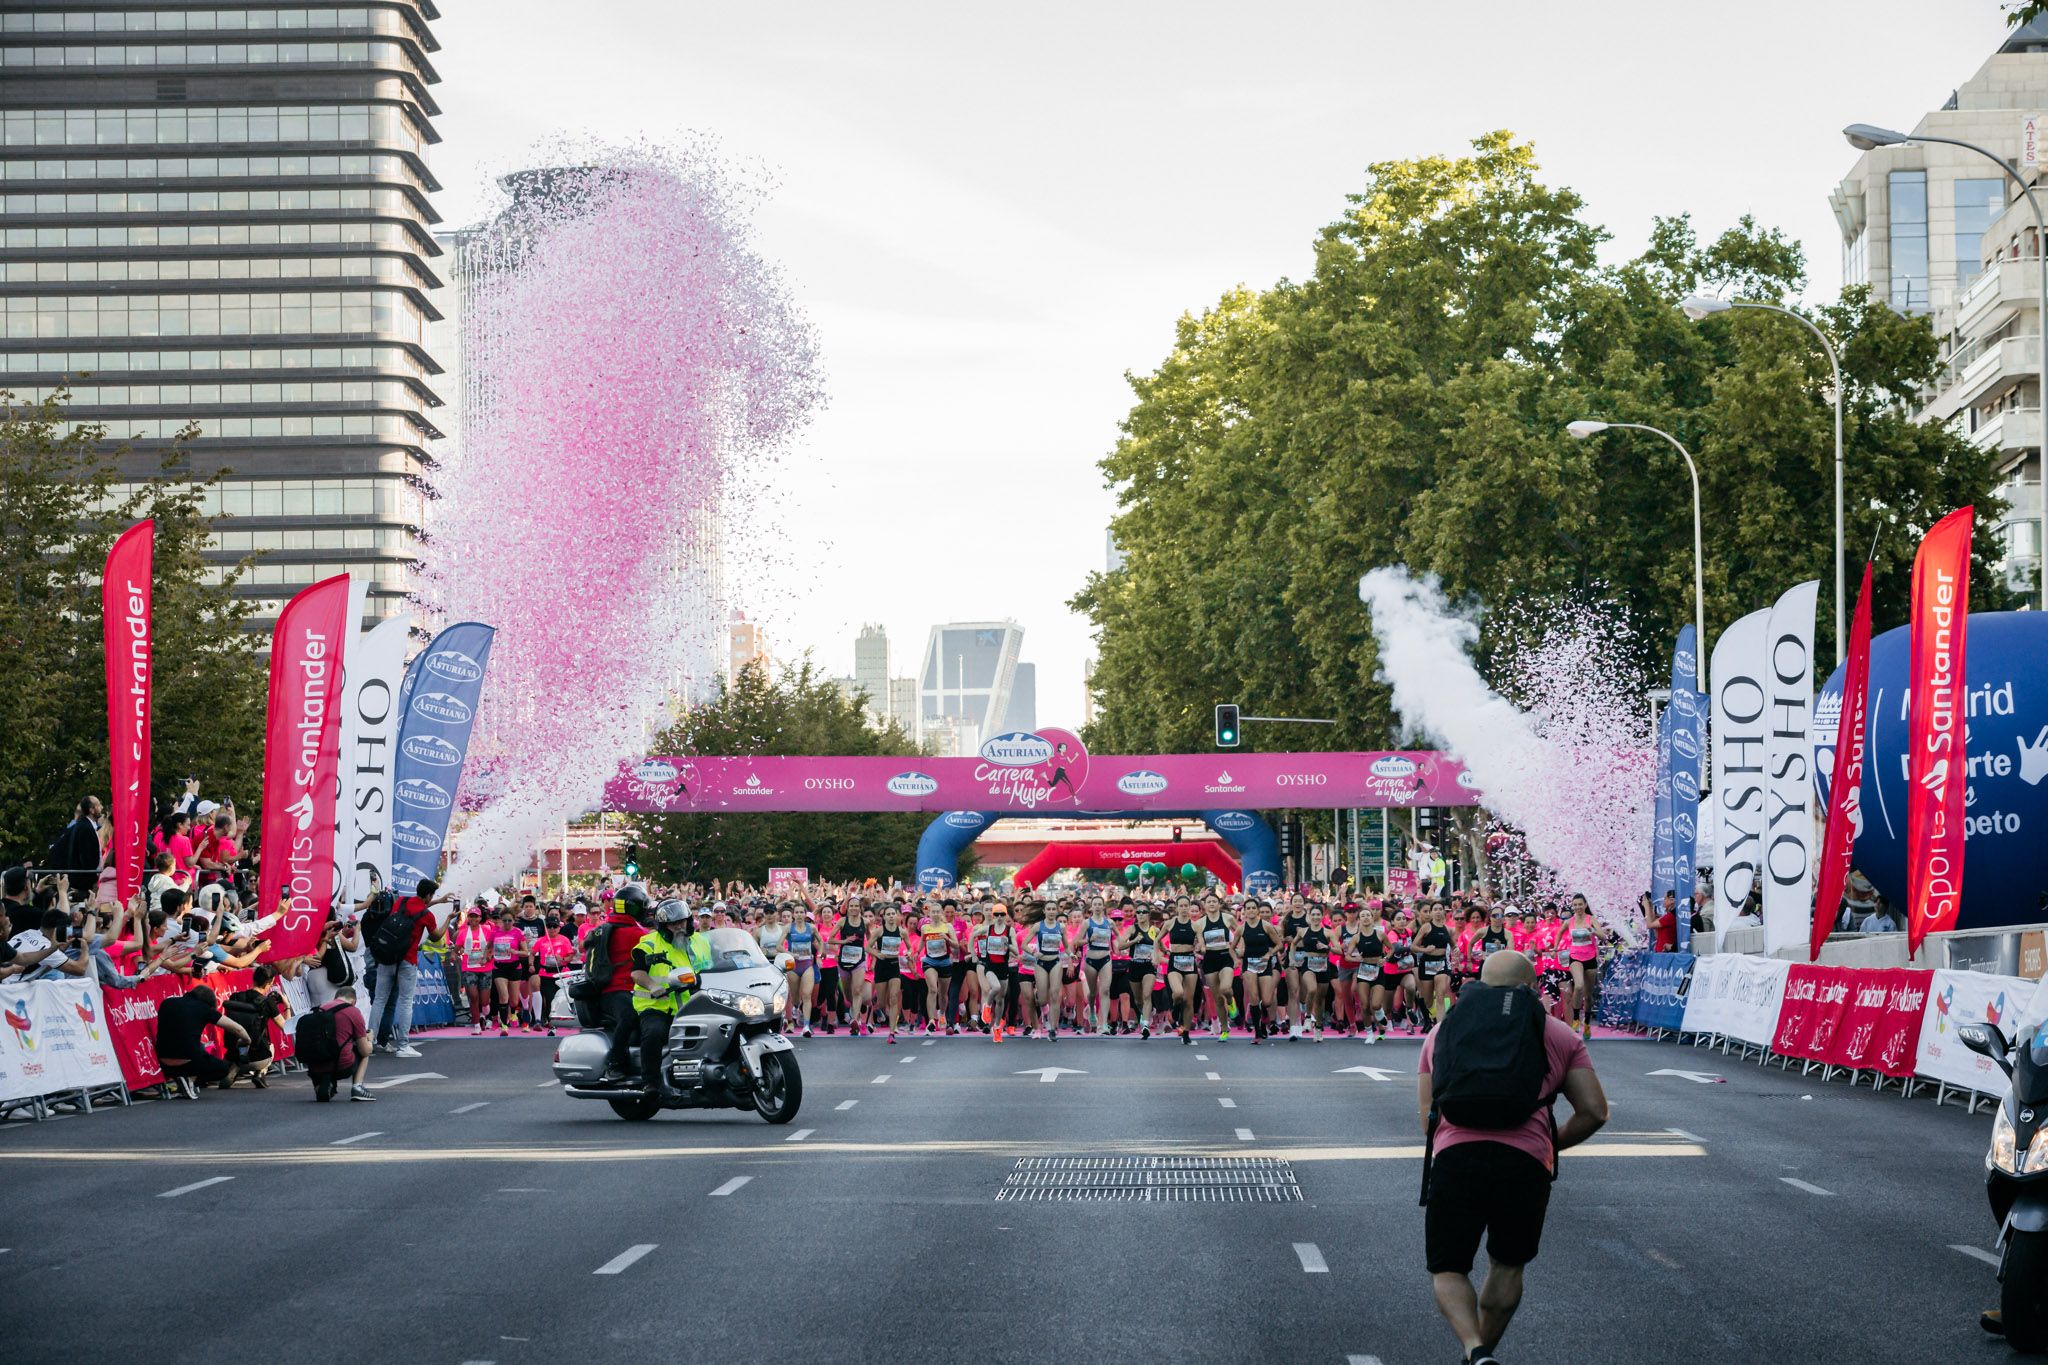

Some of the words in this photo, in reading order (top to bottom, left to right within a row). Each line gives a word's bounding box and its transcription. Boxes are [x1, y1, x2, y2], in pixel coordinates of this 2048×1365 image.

[429, 656, 477, 679] ASTURIANA
[1927, 568, 1954, 753] Santander
[294, 628, 327, 787] Santander
[416, 698, 466, 720] ASTURIANA
[405, 741, 456, 763] ASTURIANA
[987, 744, 1048, 757] ASTURIANA
[1768, 633, 1807, 886] OYSHO
[974, 763, 1035, 781] Carrera
[1374, 764, 1413, 773] ASTURIANA
[804, 778, 855, 790] OYSHO
[890, 781, 934, 791] ASTURIANA
[1120, 779, 1164, 789] ASTURIANA
[1204, 785, 1246, 793] Santander
[1276, 774, 1328, 786] OYSHO
[1366, 776, 1405, 788] Carrera
[396, 785, 446, 806] ASTURIANA
[733, 787, 774, 795] Santander
[989, 782, 1000, 794] de
[1002, 782, 1011, 794] la
[1008, 779, 1056, 808] Mujer
[1388, 786, 1419, 804] Mujer
[1721, 675, 1764, 910] OYSHO
[1099, 851, 1121, 859] Sports
[1130, 850, 1166, 858] Santander
[1390, 870, 1408, 879] SUB
[283, 836, 314, 932] Sports
